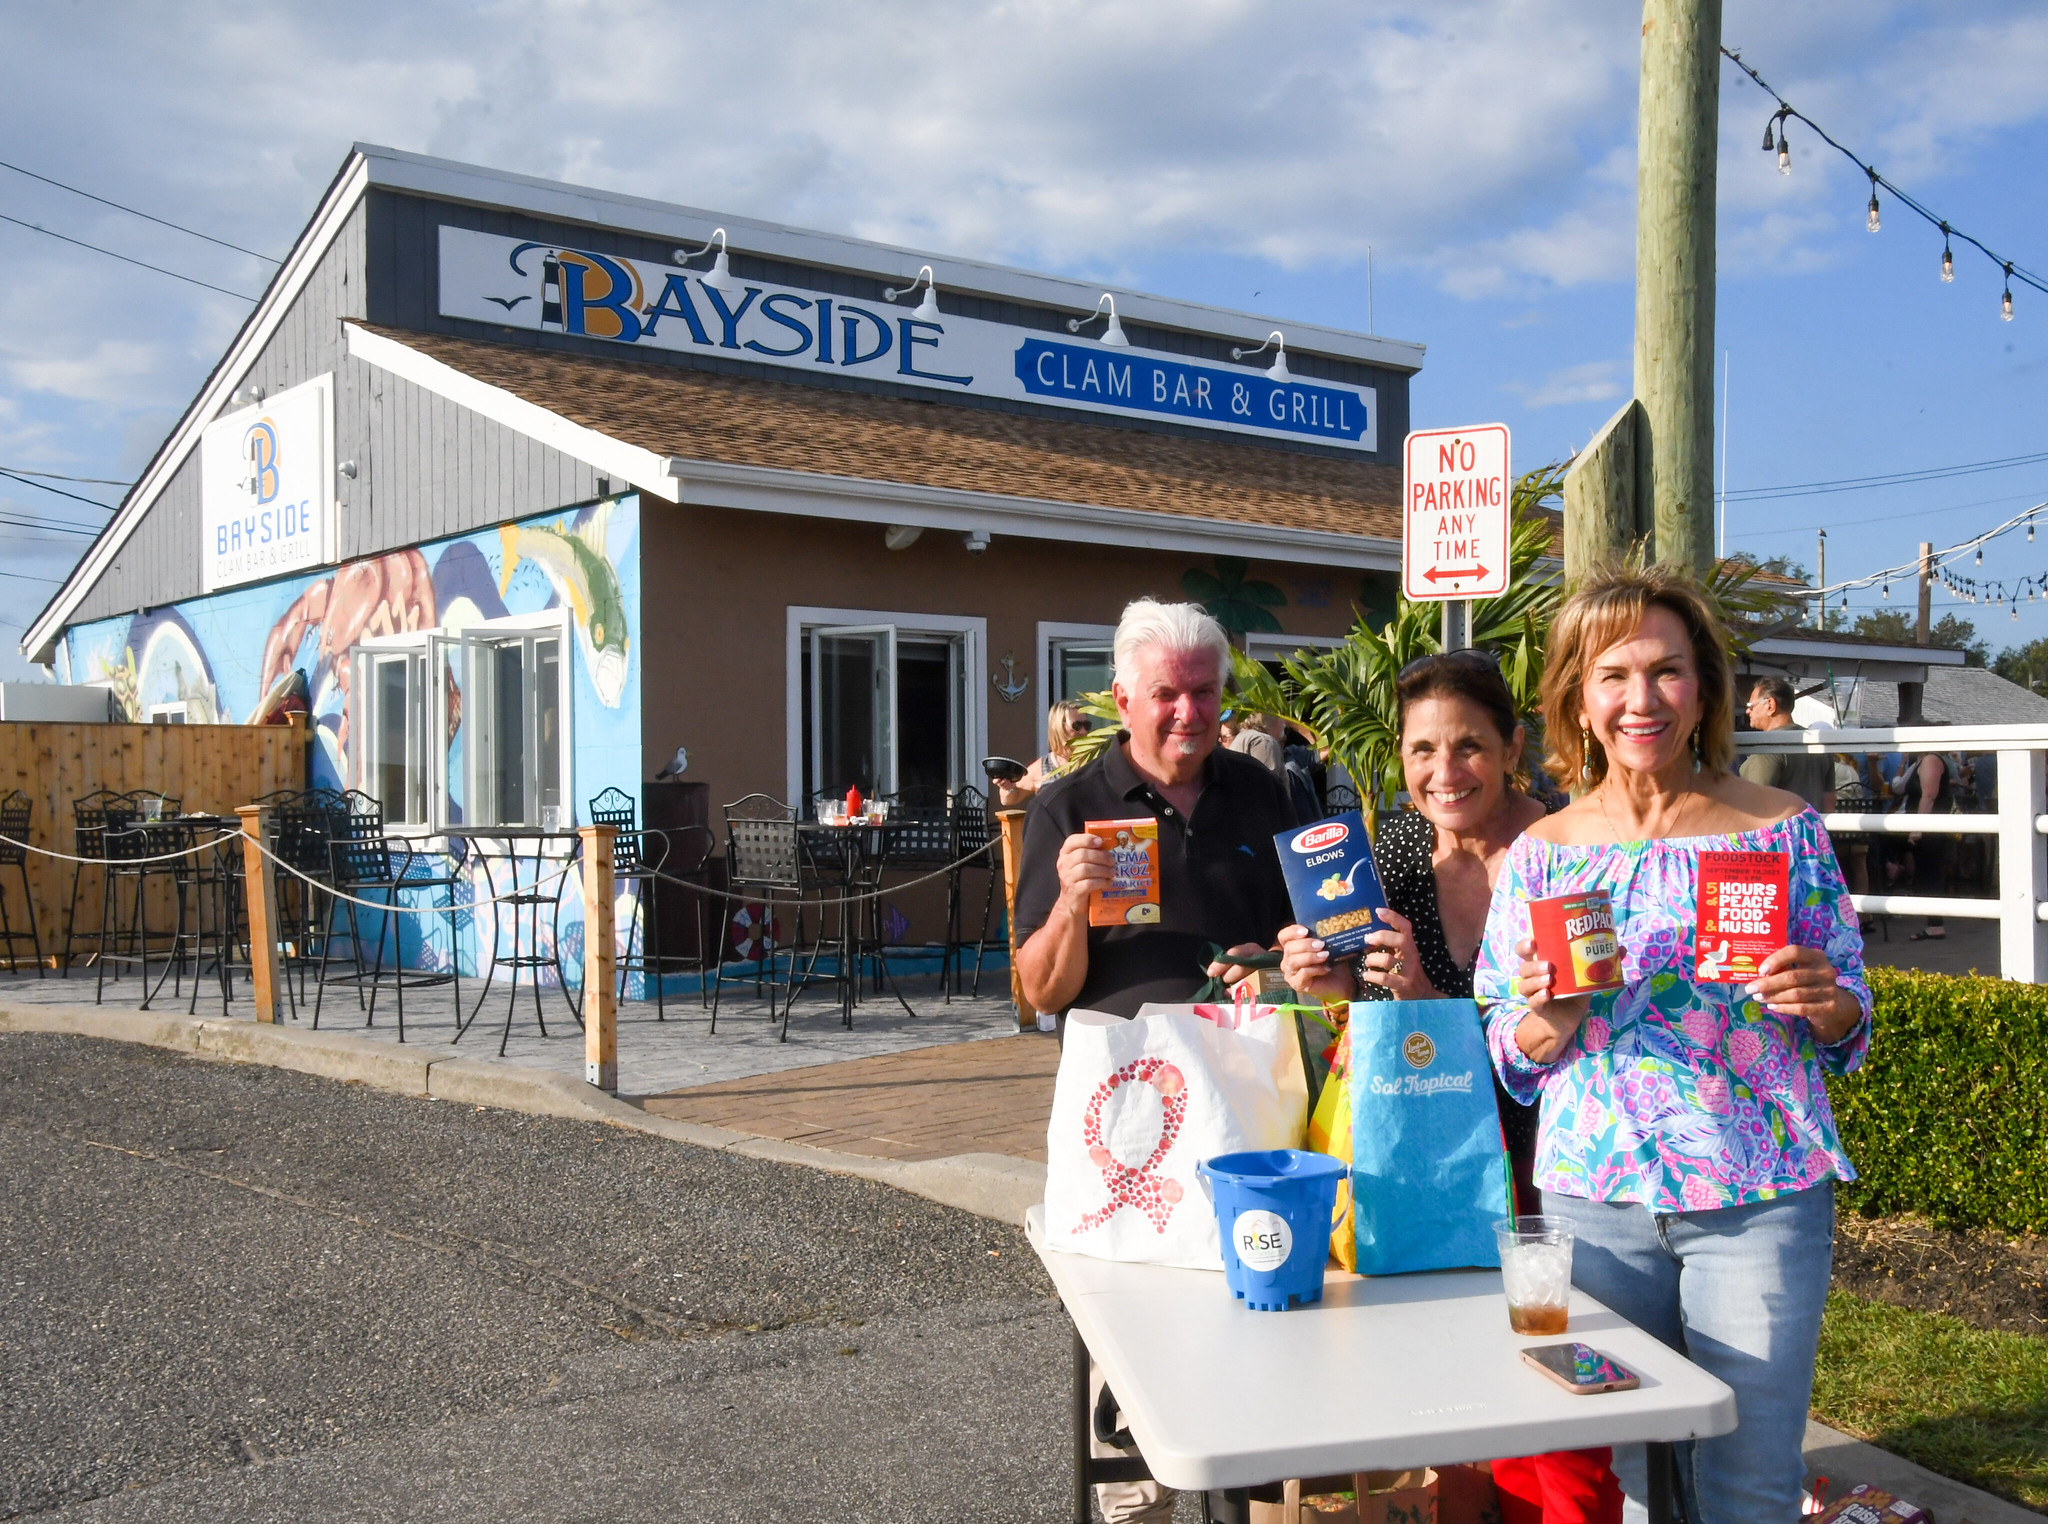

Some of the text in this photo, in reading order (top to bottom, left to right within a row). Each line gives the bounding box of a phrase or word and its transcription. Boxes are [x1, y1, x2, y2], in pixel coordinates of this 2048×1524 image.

[510, 241, 974, 387] BAYSIDE
[1037, 351, 1351, 431] CLAM BAR & GRILL
[1439, 441, 1476, 473] NO
[1413, 477, 1500, 512] PARKING
[217, 499, 310, 555] BAYSIDE
[1437, 514, 1476, 535] ANY
[247, 549, 265, 572] BAR
[281, 538, 311, 563] GRILL
[1433, 539, 1480, 560] TIME
[1304, 826, 1344, 847] Barilla
[1110, 850, 1149, 864] EMA
[1305, 848, 1345, 868] ELBOWS
[1705, 852, 1780, 864] FOODSTOCK
[1114, 863, 1149, 878] ROZ
[1705, 867, 1750, 875] SEPTEMBER
[1706, 882, 1777, 896] 5 HOURS
[1705, 895, 1778, 911] of PEACE,
[1565, 911, 1614, 940] REDPAC
[1705, 920, 1771, 934] & MUSIC
[1585, 943, 1614, 956] PUREE
[1370, 1071, 1473, 1097] Sol Tropical
